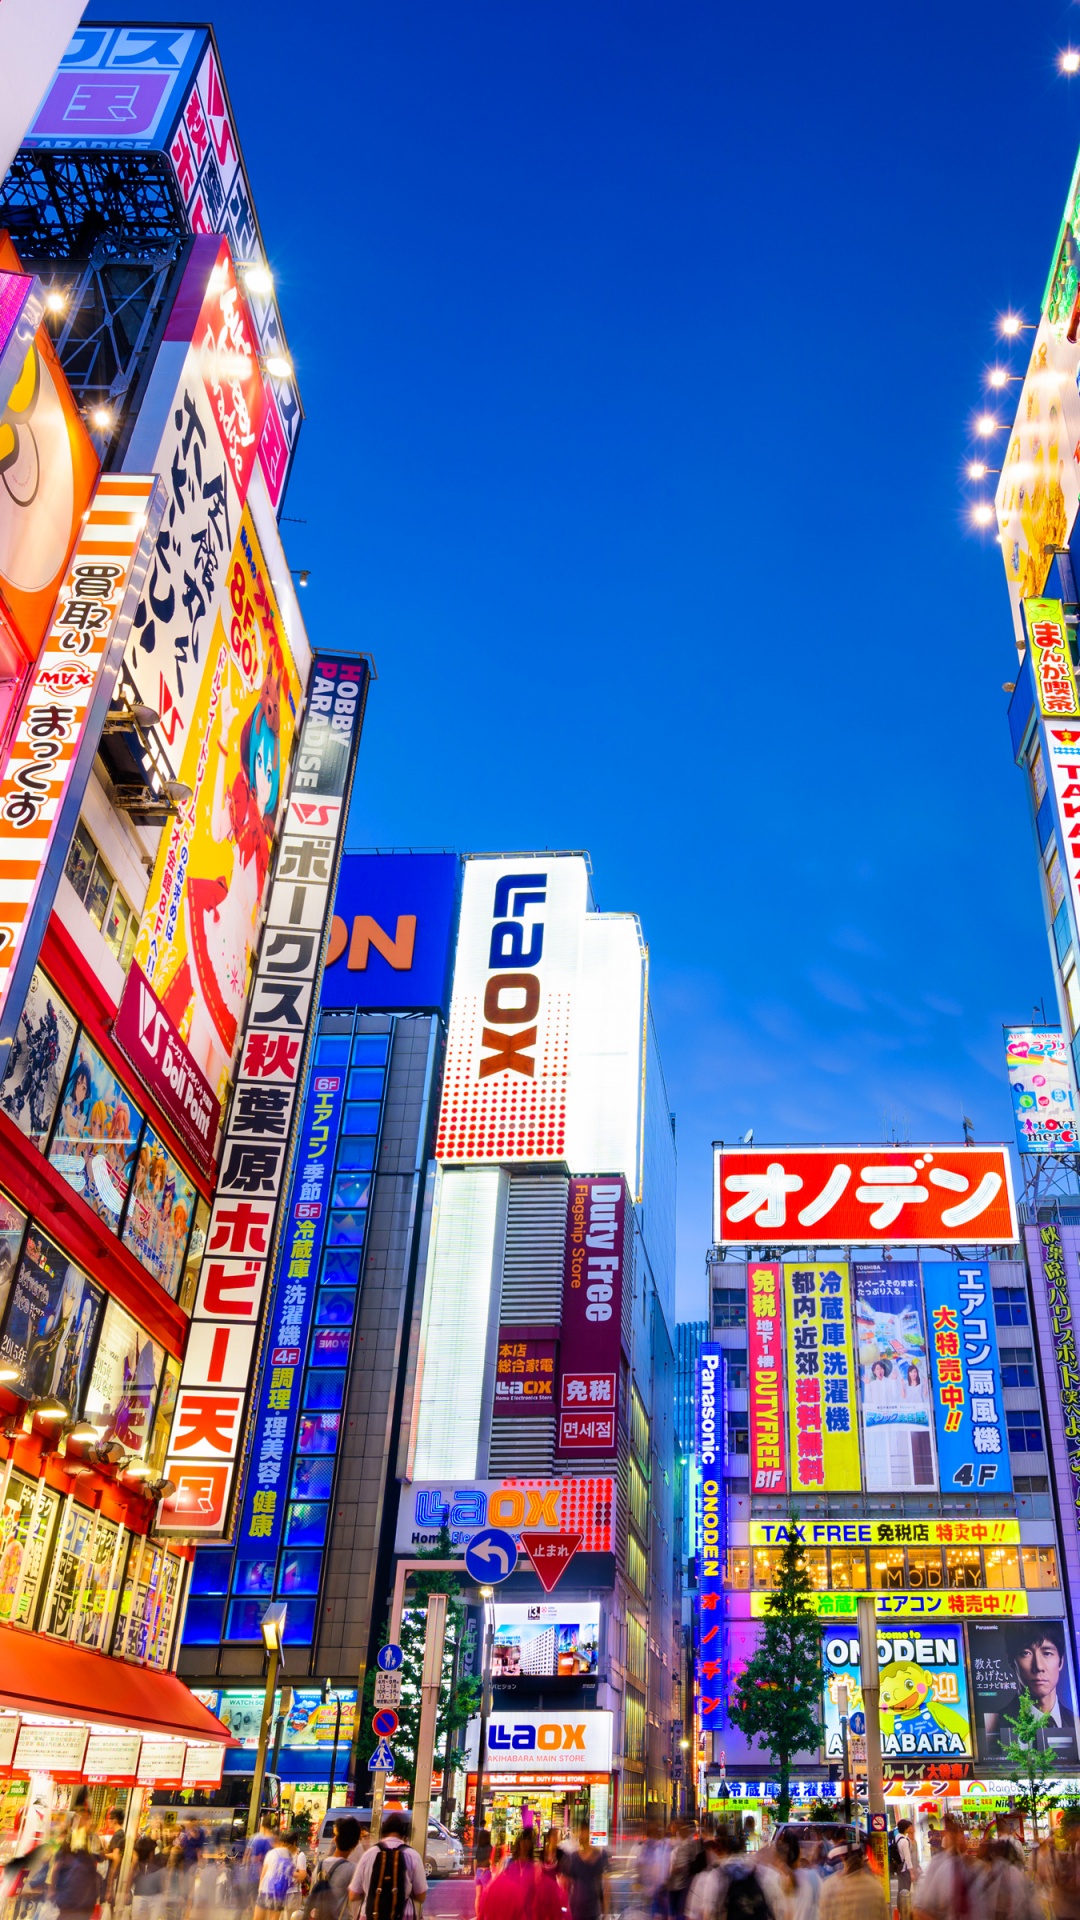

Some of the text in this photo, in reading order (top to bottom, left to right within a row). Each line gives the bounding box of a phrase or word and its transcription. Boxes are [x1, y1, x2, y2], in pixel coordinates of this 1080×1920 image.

[59, 565, 121, 653] 買取り
[1034, 621, 1075, 712] まんが喫茶
[328, 664, 361, 748] HOBBY
[295, 661, 338, 789] PARADISE
[7, 705, 76, 826] まっくす
[162, 1045, 186, 1100] Doll
[183, 1083, 211, 1141] Point
[317, 1078, 336, 1090] 6F
[725, 1153, 1003, 1230] オノデン
[297, 1205, 319, 1217] 5F
[571, 1184, 588, 1289] Flagship Store
[585, 1184, 622, 1322] Duty Free
[857, 1280, 918, 1288] スペースそのまま、
[857, 1288, 904, 1296] たっぷり入る。
[752, 1269, 776, 1318] 免税
[275, 1350, 297, 1364] 4F
[499, 1344, 527, 1357] 本店
[498, 1358, 553, 1373] 総合家電
[958, 1269, 1001, 1453] エアコン扇風機
[567, 1380, 611, 1401] 免税
[755, 1371, 780, 1469] DUTYFREE
[564, 1421, 611, 1439] 면세점
[755, 1471, 782, 1488] B1F
[411, 1532, 439, 1544] Hom
[702, 1354, 722, 1715] Panasonic ONODEN オノデン
[813, 1525, 872, 1542] FREE
[877, 1524, 929, 1542] 免税店
[533, 1543, 570, 1558] 止まれ
[877, 1596, 942, 1613] エアコン
[948, 1595, 1017, 1613] 特売中!!
[974, 1658, 1001, 1670] 教えて
[976, 1670, 1013, 1681] あげたい
[559, 1754, 586, 1762] STORE
